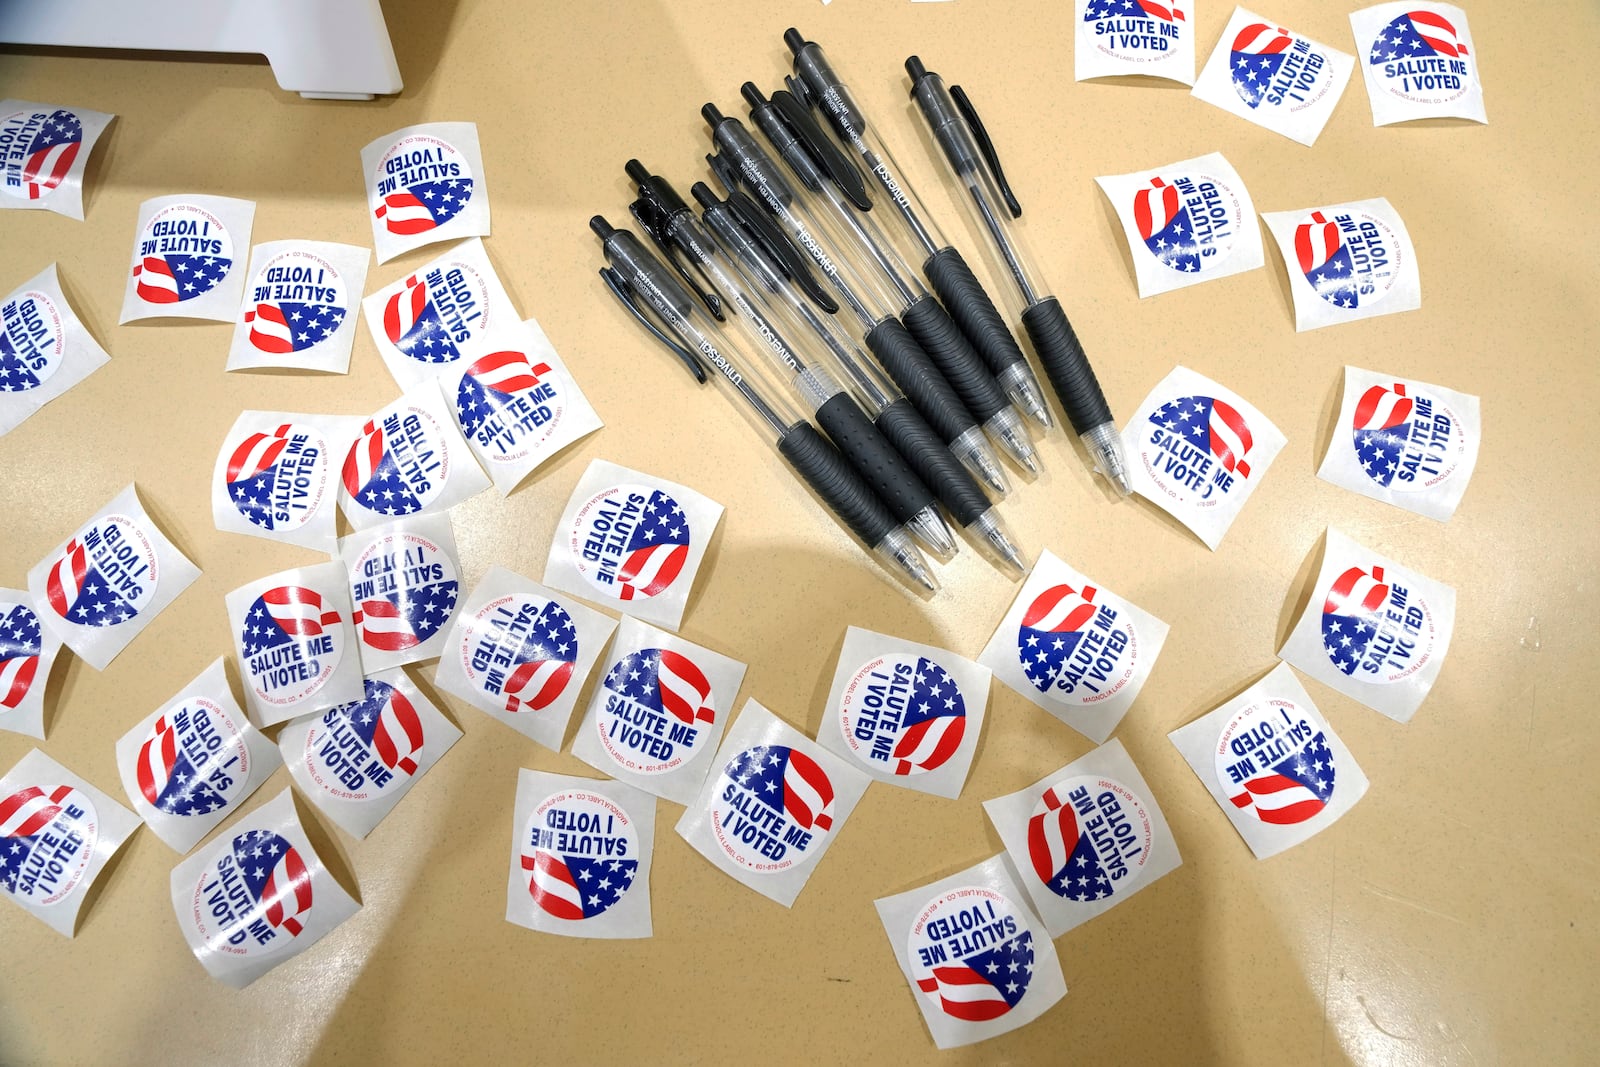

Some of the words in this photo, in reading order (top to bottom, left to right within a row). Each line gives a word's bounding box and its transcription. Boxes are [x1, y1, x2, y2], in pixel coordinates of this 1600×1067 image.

[1095, 19, 1155, 35] SALUTE
[1159, 22, 1179, 39] ME
[1109, 35, 1114, 49] I
[1119, 34, 1168, 51] VOTED
[1266, 51, 1304, 105] SALUTE
[1292, 38, 1310, 54] ME
[1293, 52, 1324, 91] VOTED
[1384, 58, 1446, 78] SALUTE
[1448, 59, 1467, 75] ME
[1402, 77, 1409, 92] I
[1412, 74, 1460, 90] VOTED
[1289, 92, 1304, 102] I
[8, 112, 47, 161] SALUTE
[385, 148, 433, 175] VOTED
[436, 147, 443, 161] I
[5, 162, 22, 187] ME
[377, 175, 396, 197] ME
[398, 162, 460, 187] SALUTE
[872, 162, 911, 208] universal
[1173, 176, 1197, 195] ME
[1197, 182, 1228, 230] VOTED
[152, 219, 197, 237] VOTED
[202, 220, 209, 236] I
[1185, 195, 1216, 257] SALUTE
[1334, 213, 1357, 232] ME
[140, 238, 157, 256] ME
[159, 236, 222, 254] SALUTE
[797, 230, 837, 275] universal
[1358, 221, 1388, 268] VOTED
[266, 266, 312, 283] VOTED
[317, 268, 324, 284] I
[425, 267, 444, 289] ME
[253, 285, 271, 302] ME
[273, 284, 336, 303] SALUTE
[445, 268, 475, 314] VOTED
[1, 299, 18, 321] ME
[18, 298, 48, 342] VOTED
[431, 285, 471, 343] SALUTE
[465, 310, 481, 322] I
[5, 316, 47, 370] SALUTE
[39, 337, 55, 349] I
[757, 323, 796, 368] universal
[698, 339, 742, 384] universal
[527, 382, 557, 405] ME
[1415, 395, 1432, 419] ME
[382, 412, 401, 436] ME
[495, 438, 506, 454] I
[1152, 451, 1164, 466] I
[292, 447, 318, 498] VOTED
[424, 460, 440, 472] I
[1149, 429, 1213, 475] SALUTE
[1212, 467, 1234, 493] ME
[1421, 465, 1438, 475] I
[274, 458, 296, 522] SALUTE
[285, 433, 308, 454] ME
[603, 498, 621, 507] I
[582, 509, 617, 561] VOTED
[604, 492, 645, 557] SALUTE
[83, 526, 102, 551] ME
[102, 523, 139, 571] VOTED
[416, 545, 424, 564] I
[91, 545, 143, 600] SALUTE
[132, 563, 148, 577] I
[596, 557, 618, 585] ME
[353, 579, 375, 601] ME
[1389, 582, 1408, 609] ME
[496, 607, 514, 618] I
[250, 642, 302, 675] SALUTE
[306, 634, 334, 656] ME
[1056, 628, 1105, 694] SALUTE
[1093, 603, 1117, 632] ME
[1087, 629, 1128, 682] VOTED
[857, 659, 882, 677] MAGNOLIA
[870, 671, 889, 680] I
[1387, 659, 1404, 670] I
[262, 674, 268, 690] I
[483, 667, 505, 696] ME
[847, 677, 859, 694] LABEL
[1082, 689, 1112, 702] MAGNOLIA
[1111, 677, 1126, 693] LABEL
[1123, 667, 1132, 677] CO.
[1082, 679, 1099, 692] I
[843, 695, 851, 705] CO.
[878, 662, 912, 733] SALUTE
[173, 706, 191, 736] ME
[605, 694, 668, 736] SALUTE
[667, 721, 698, 748] ME
[854, 684, 887, 741] VOTED
[1279, 707, 1292, 725] I
[322, 707, 371, 768] SALUTE
[362, 759, 394, 789] ME
[608, 718, 619, 738] I
[619, 722, 673, 761] VOTED
[869, 734, 894, 762] ME
[1253, 719, 1312, 768] SALUTE
[222, 755, 239, 769] I
[319, 739, 365, 791] VOTED
[1225, 756, 1257, 784] ME
[1068, 785, 1096, 816] ME
[1137, 807, 1145, 818] CO.
[546, 808, 601, 833] VOTED
[606, 814, 613, 834] I
[722, 783, 786, 837] SALUTE
[782, 824, 813, 852] ME
[1096, 791, 1136, 850] VOTED
[1142, 818, 1150, 836] LABEL
[530, 826, 553, 848] ME
[556, 831, 627, 857] SALUTE
[712, 810, 724, 842] MAGNOLIA
[721, 840, 736, 857] LABEL
[735, 854, 746, 864] CO.
[721, 809, 735, 828] I
[732, 815, 787, 861] VOTED
[1084, 814, 1128, 881] SALUTE
[18, 831, 60, 895] SALUTE
[1124, 846, 1142, 859] I
[1138, 837, 1150, 865] MAGNOLIA
[37, 882, 53, 895] I
[202, 879, 219, 894] I
[216, 854, 254, 919] SALUTE
[246, 916, 277, 945] ME
[984, 899, 995, 920] I
[925, 904, 987, 942] VOTED
[947, 915, 1017, 959] SALUTE
[917, 943, 948, 967] ME
